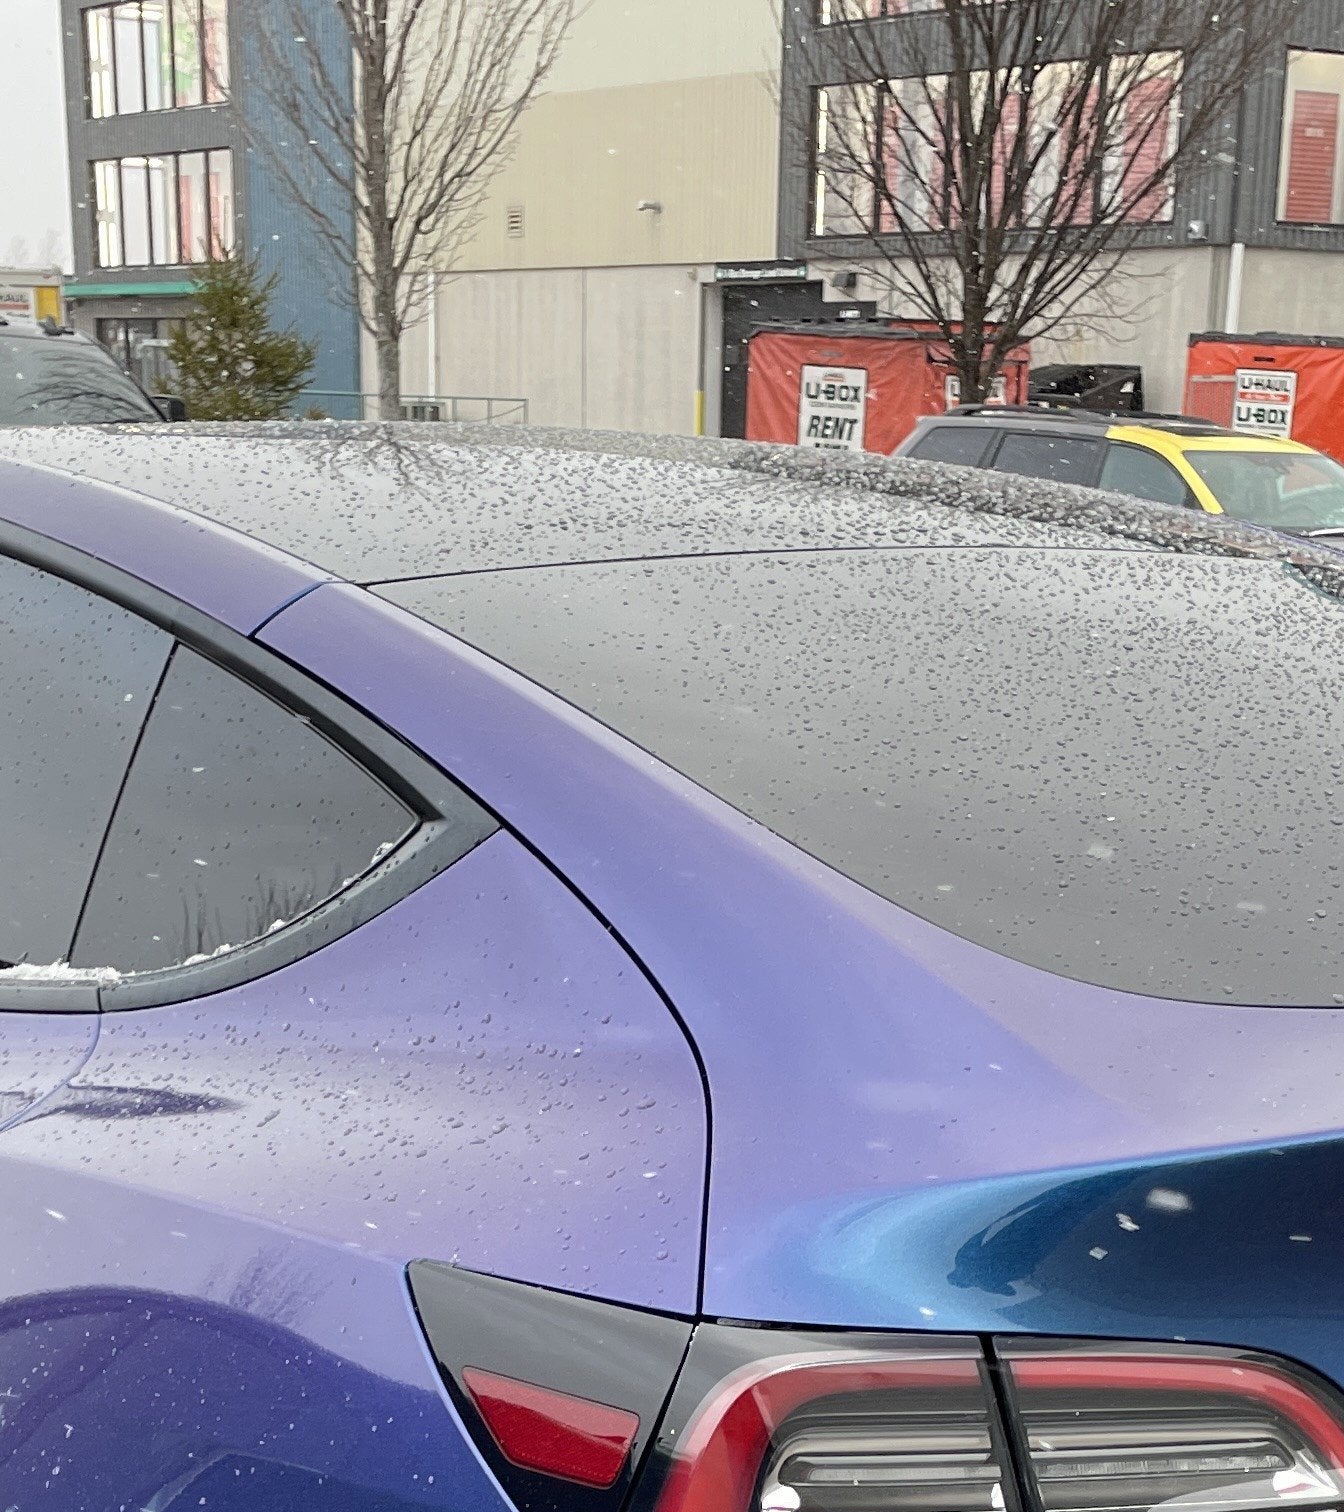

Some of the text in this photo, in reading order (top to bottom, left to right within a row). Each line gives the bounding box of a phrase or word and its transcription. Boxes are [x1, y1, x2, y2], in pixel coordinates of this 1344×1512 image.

[805, 382, 861, 403] U-BOX
[1236, 406, 1288, 426] U-BOX
[807, 414, 859, 441] RENT
